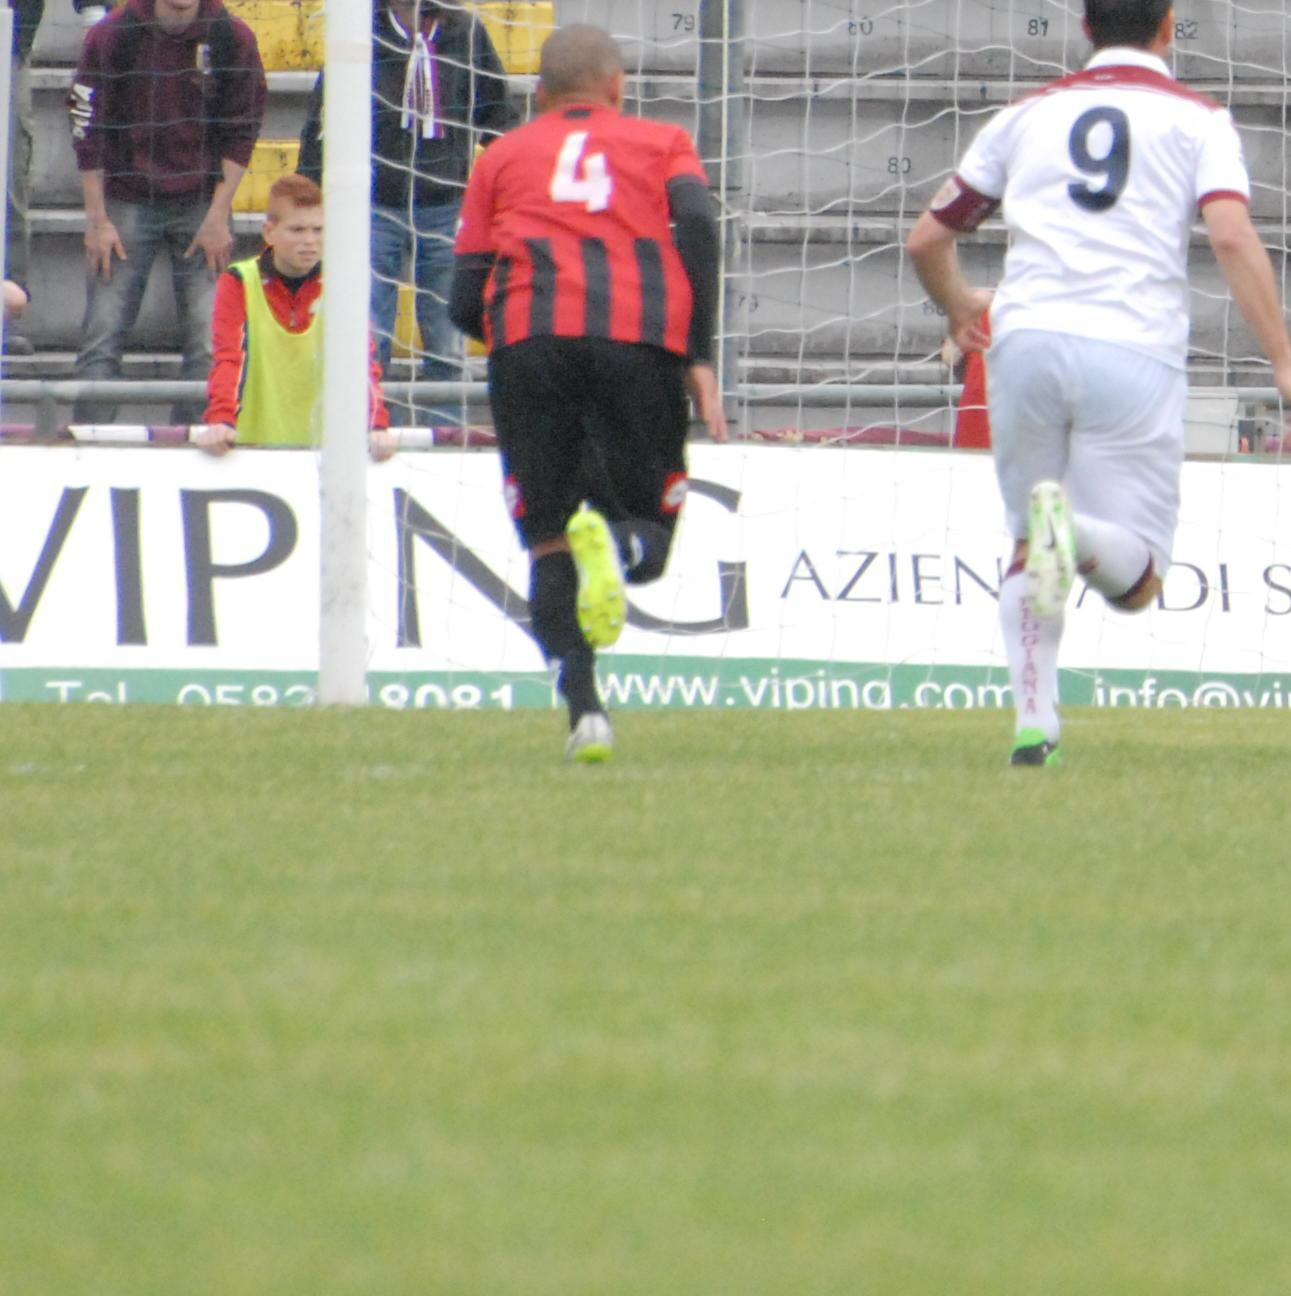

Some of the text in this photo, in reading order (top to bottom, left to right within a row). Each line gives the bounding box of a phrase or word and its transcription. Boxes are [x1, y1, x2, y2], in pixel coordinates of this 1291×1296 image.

[669, 13, 697, 34] 79
[1028, 16, 1050, 37] 81
[550, 131, 612, 213] 4
[1068, 106, 1130, 214] 9
